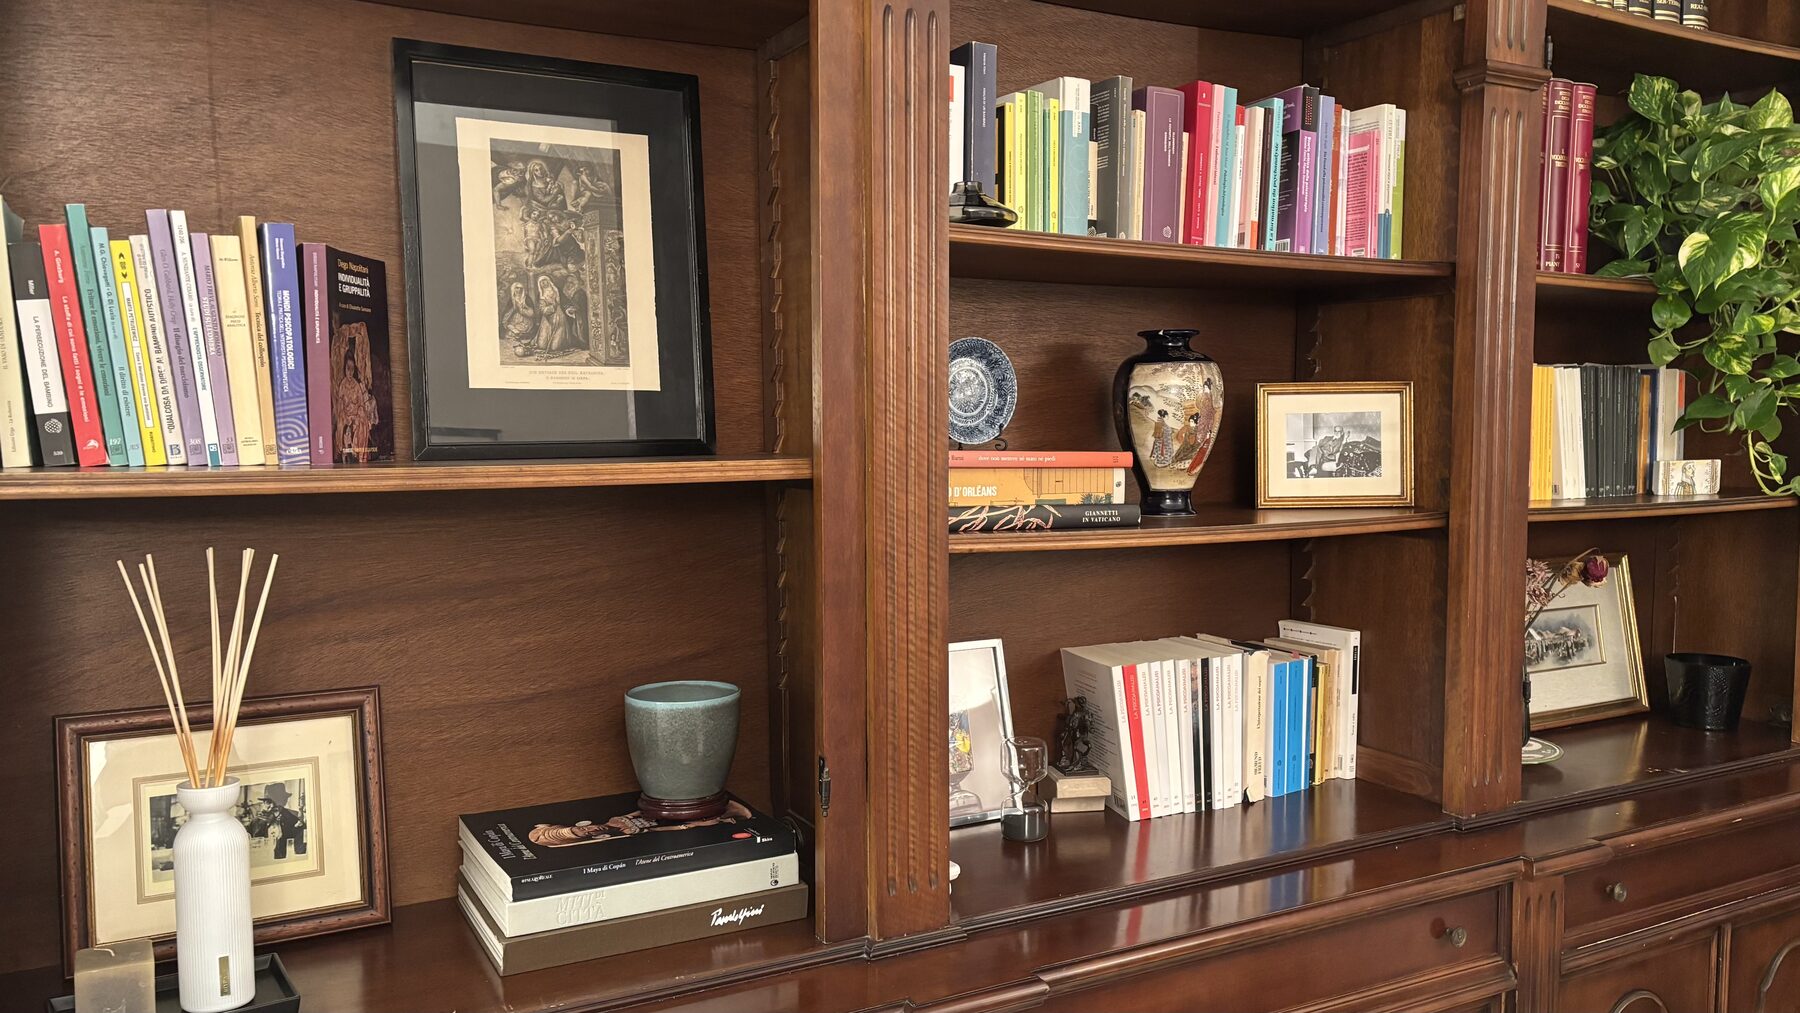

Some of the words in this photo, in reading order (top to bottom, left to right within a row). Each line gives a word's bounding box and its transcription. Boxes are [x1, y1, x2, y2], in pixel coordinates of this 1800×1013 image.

[54, 257, 65, 283] Ginzburg
[87, 288, 97, 309] Evitare
[281, 289, 291, 311] MONDI
[342, 285, 370, 297] GRUPPALITÀ
[63, 303, 72, 320] stoffa
[143, 287, 157, 322] AUTISTICO
[202, 265, 213, 284] MARIO
[212, 330, 223, 356] ROMANO
[32, 315, 39, 323] LA
[254, 311, 262, 331] Tecnica
[91, 315, 102, 344] emozioni,
[149, 323, 162, 354] BAMBINO
[32, 324, 47, 367] PERSECUZIONE
[282, 312, 296, 369] PSICOPATOLOGICI
[71, 352, 80, 364] fatti
[96, 344, 105, 362] vivere
[155, 355, 164, 364] AL
[256, 341, 266, 367] colloquio
[40, 368, 48, 380] DEL
[172, 332, 184, 355] disagio
[178, 365, 191, 398] narcisismo
[73, 368, 83, 385] sogni
[100, 369, 111, 396] emozioni
[118, 371, 127, 389] diritto
[42, 380, 53, 407] BAMBINO
[160, 385, 169, 395] DA
[79, 396, 90, 422] emozioni
[121, 396, 131, 416] esistere
[954, 484, 996, 496] D'ORLÉANS
[1084, 508, 1117, 518] GIANNETTI
[585, 865, 602, 875] Maya
[608, 860, 626, 871] Copán
[557, 902, 606, 925] CITTÀ
